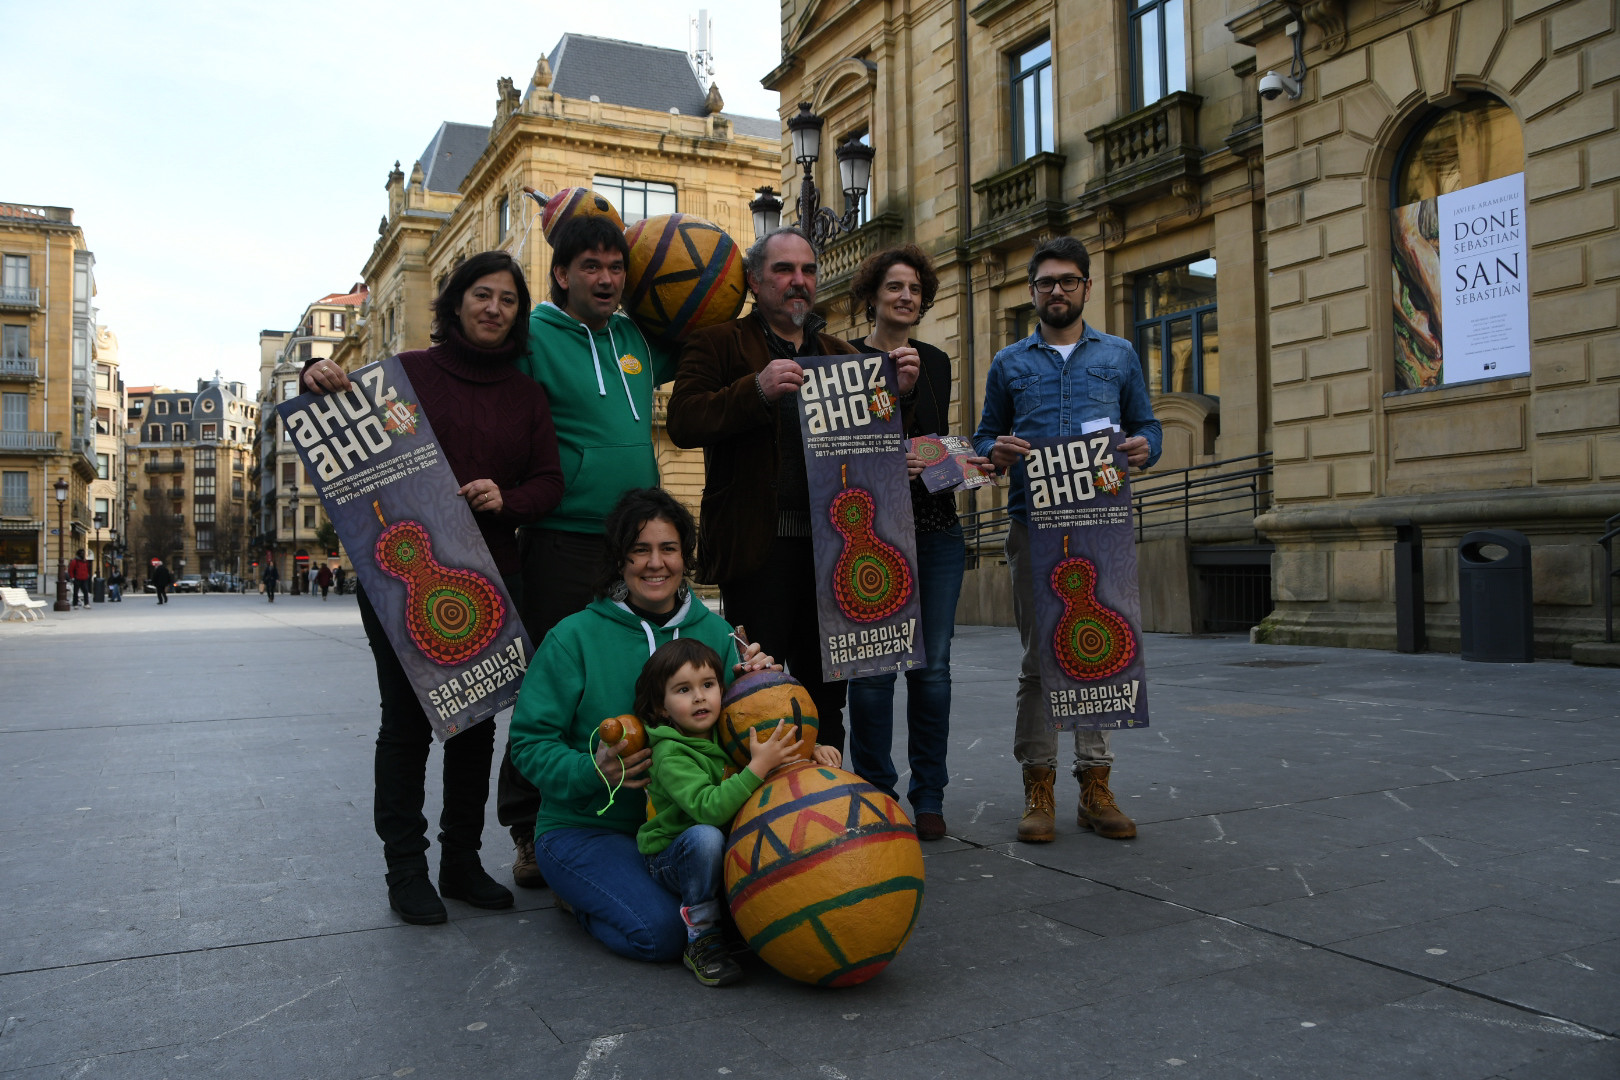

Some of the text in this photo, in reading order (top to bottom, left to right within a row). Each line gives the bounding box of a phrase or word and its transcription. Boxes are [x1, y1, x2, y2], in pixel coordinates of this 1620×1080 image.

[1454, 192, 1520, 216] JAVIER ARAMBURU
[1454, 207, 1520, 240] DONE
[1454, 229, 1520, 254] SEBASTIAN
[1456, 252, 1520, 292] SAN
[1456, 282, 1520, 306] SEBASTIÁN
[872, 391, 890, 409] 10
[385, 402, 410, 426] 10
[1098, 468, 1119, 485] 10
